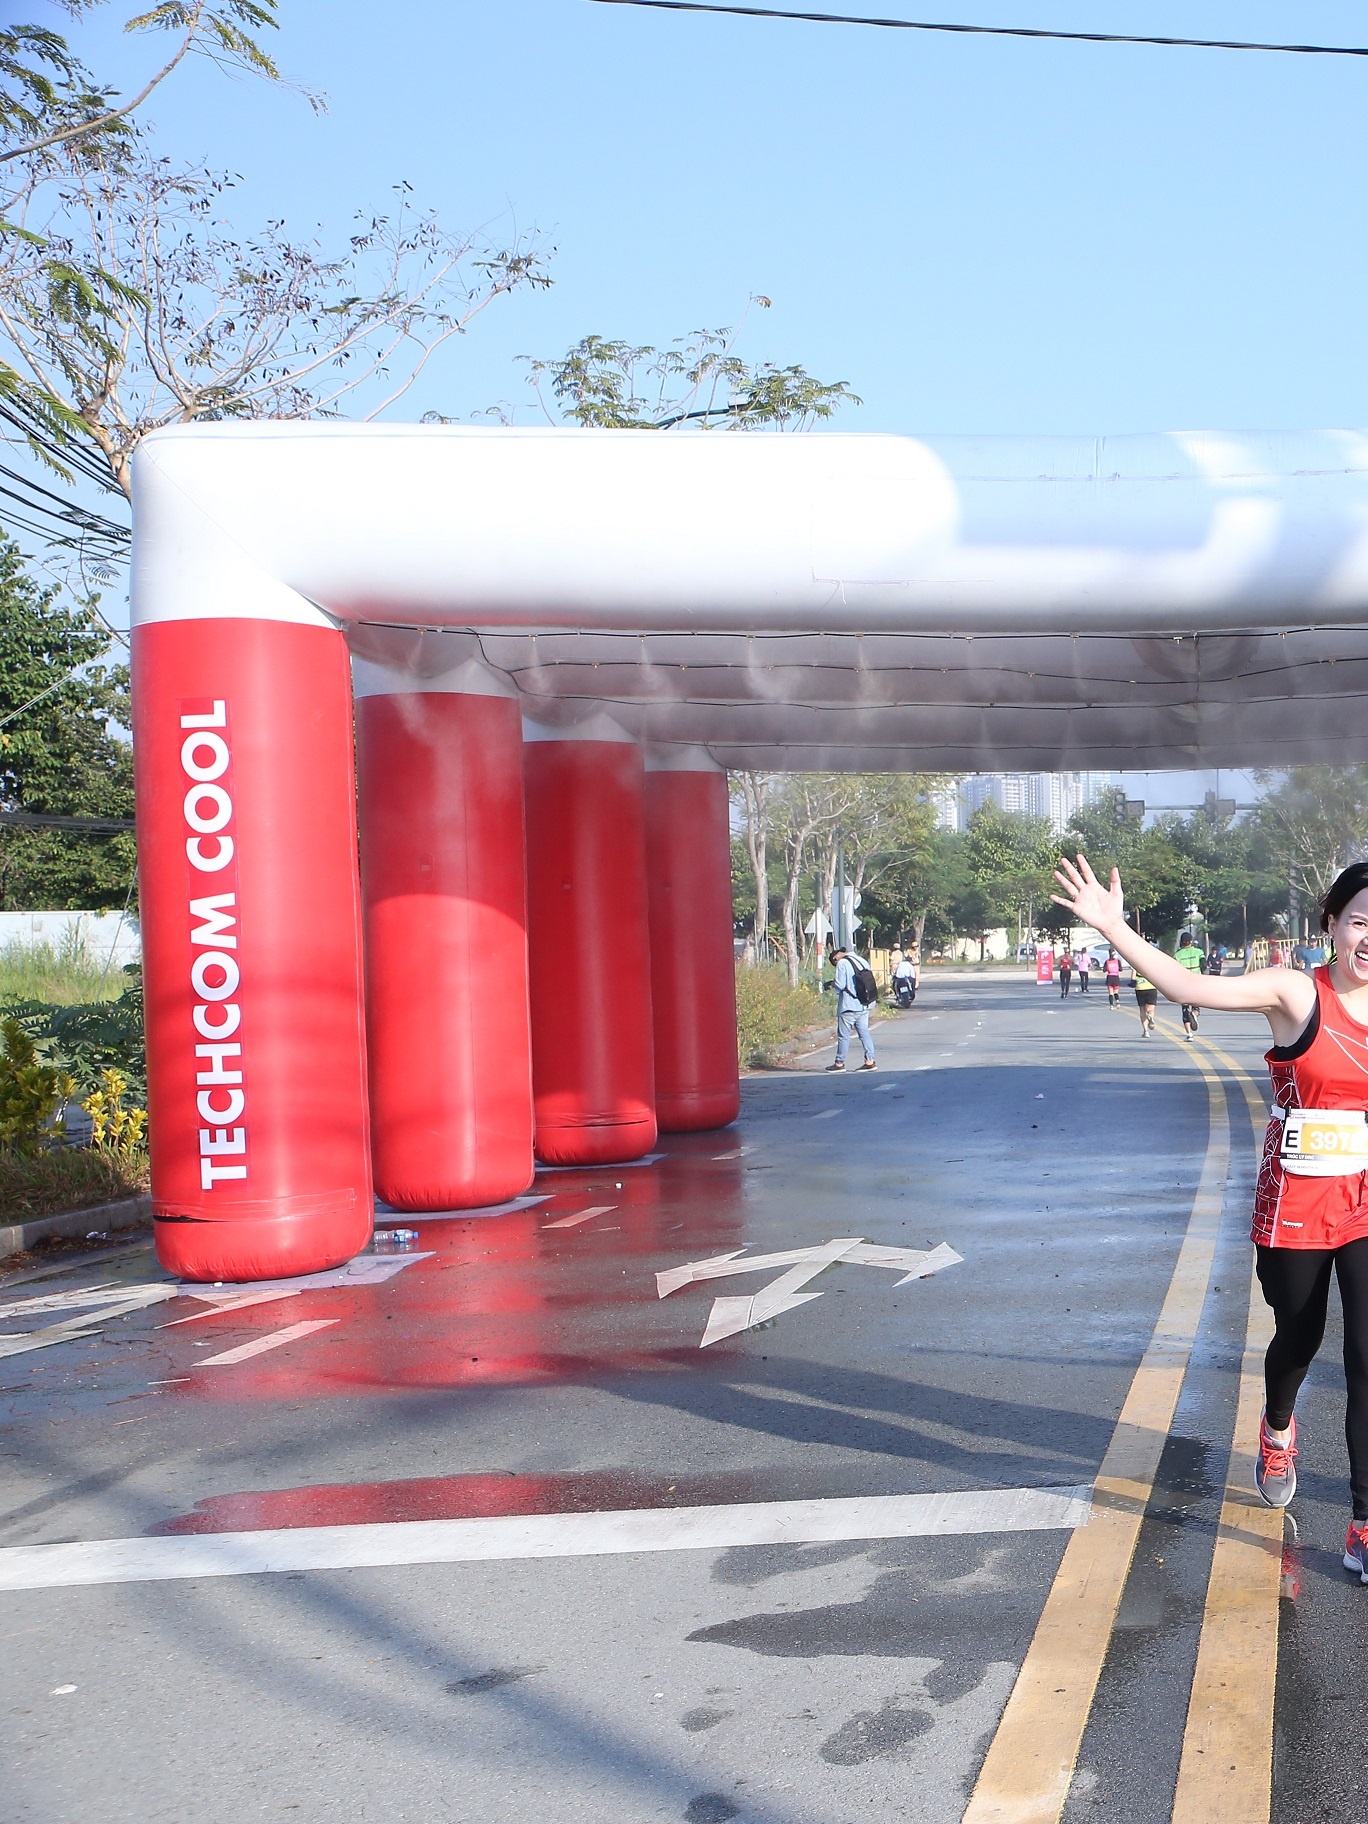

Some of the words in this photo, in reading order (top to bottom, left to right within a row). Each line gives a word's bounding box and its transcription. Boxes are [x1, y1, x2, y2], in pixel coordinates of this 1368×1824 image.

[180, 699, 234, 872] COOL
[189, 892, 247, 1190] TECHCOM
[1285, 1130, 1299, 1148] E
